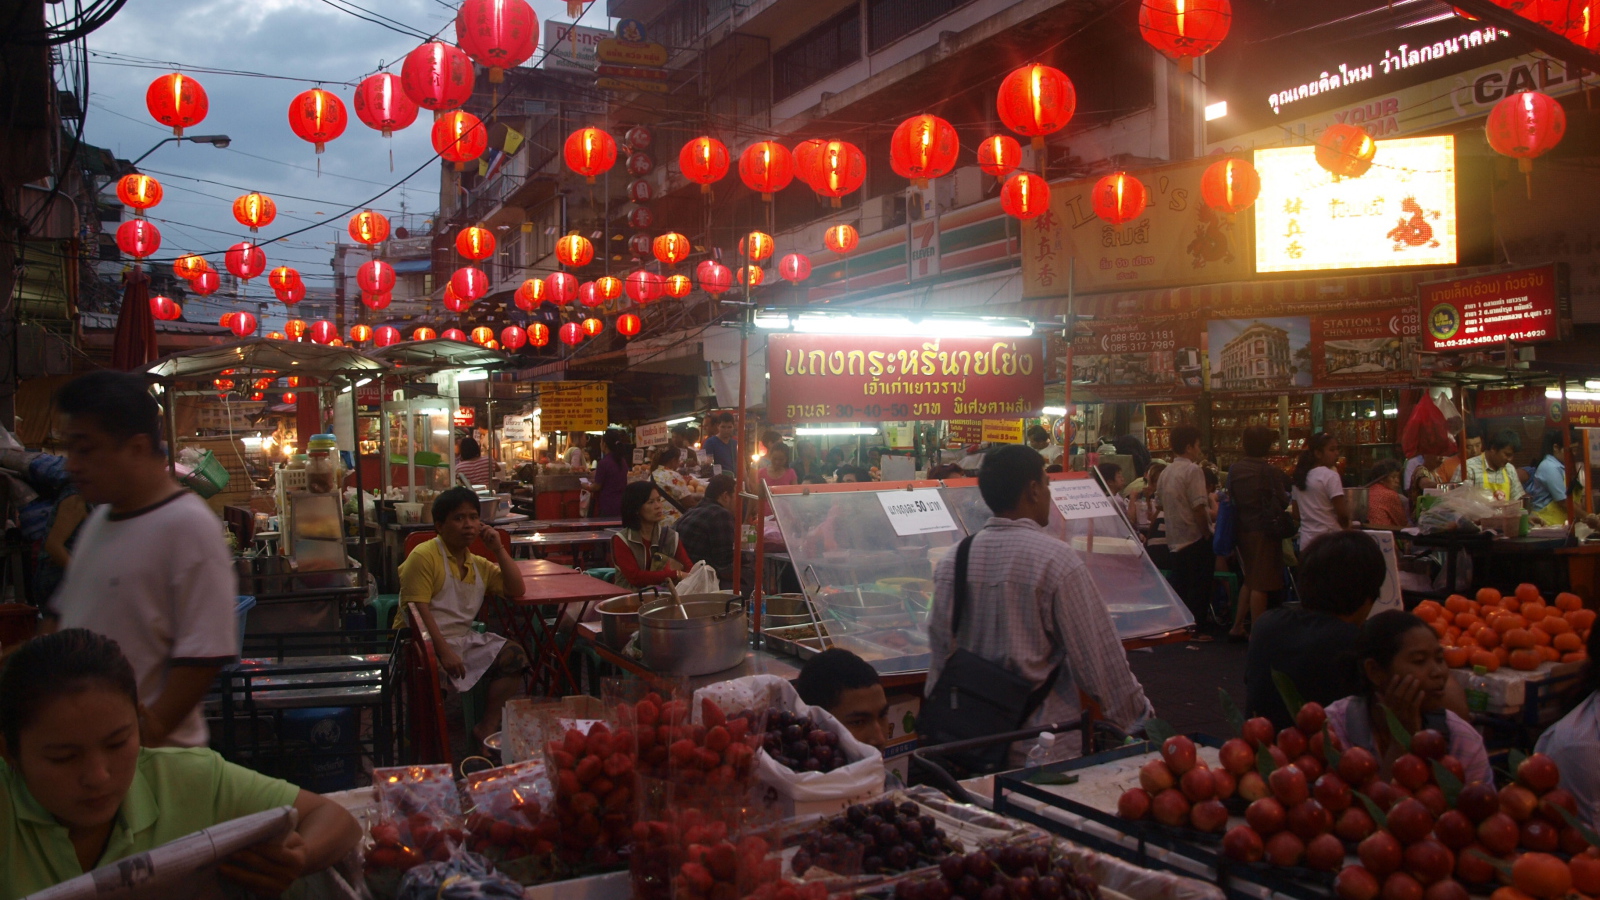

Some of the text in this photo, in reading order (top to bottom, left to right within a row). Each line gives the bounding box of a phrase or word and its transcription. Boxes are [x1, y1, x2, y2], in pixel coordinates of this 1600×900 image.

[1333, 97, 1399, 123] YOUR
[1323, 318, 1372, 329] STATION
[1323, 327, 1383, 337] CHINA TOWN
[835, 404, 909, 419] 30-40-50
[913, 401, 941, 416] บาท
[953, 395, 1032, 416] พิเศษตามสั่ง
[915, 500, 927, 512] 50
[926, 501, 943, 512] บาท
